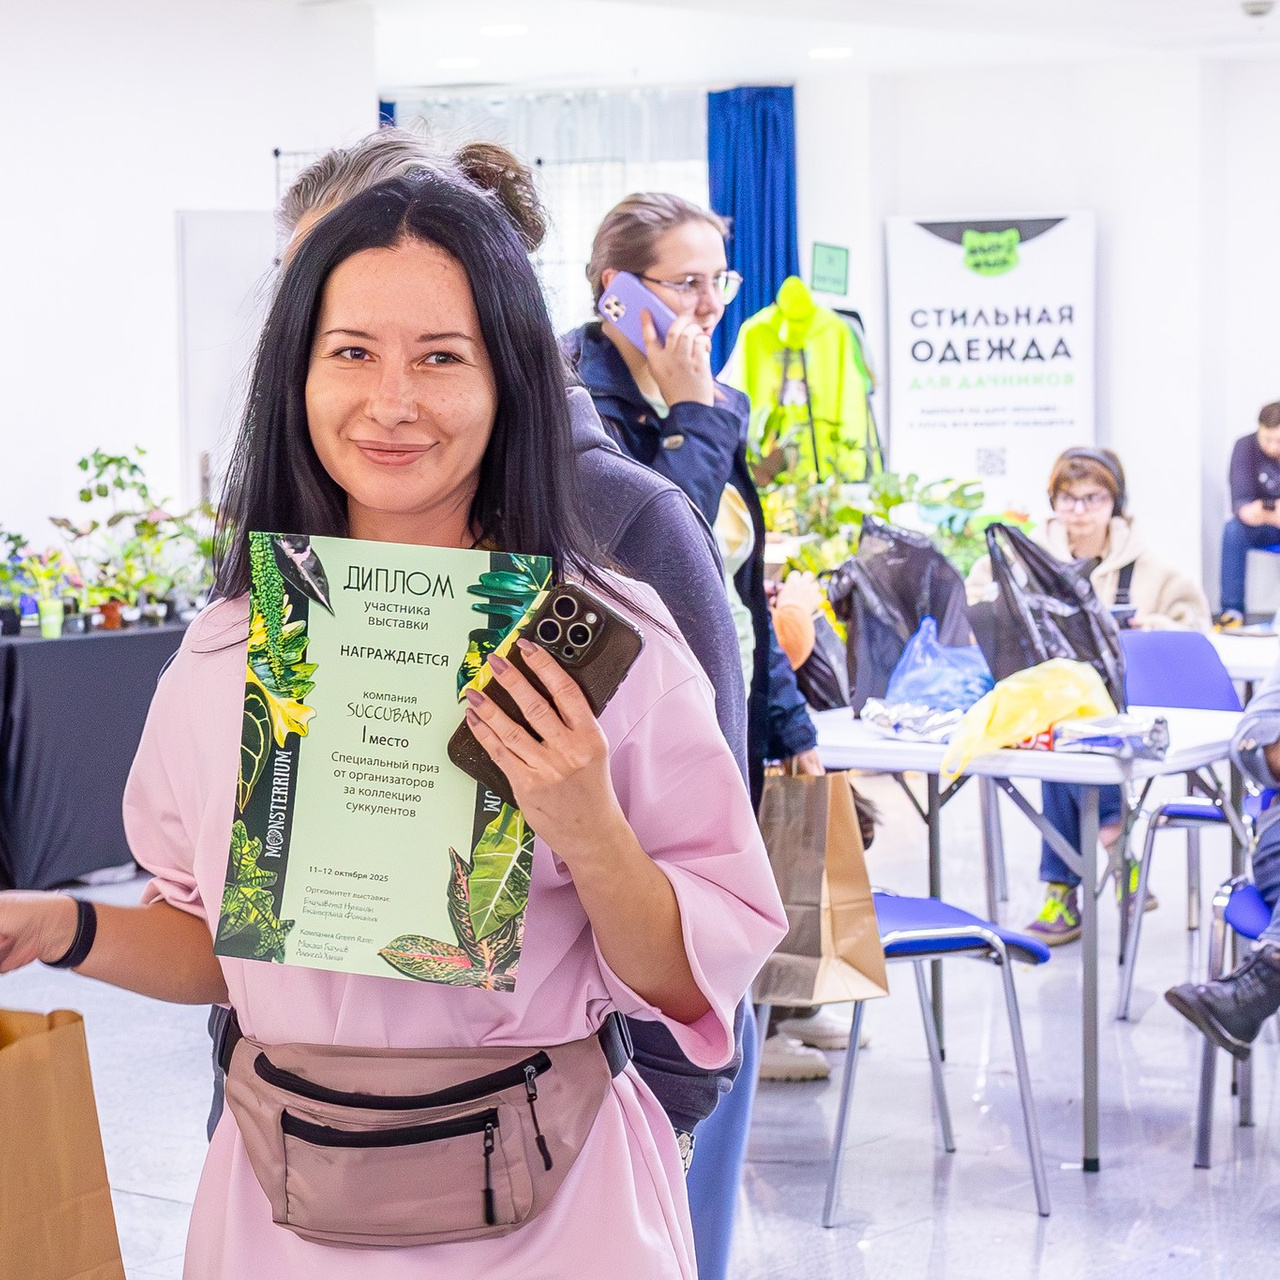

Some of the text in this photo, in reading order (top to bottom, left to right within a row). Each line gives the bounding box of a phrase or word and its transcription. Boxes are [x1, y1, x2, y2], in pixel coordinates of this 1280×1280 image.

[910, 305, 1074, 328] СТИЛЬНАЯ
[911, 337, 1072, 364] ОДЕЖДА
[343, 565, 455, 599] ДИПЛОМ
[364, 600, 431, 616] участника
[368, 616, 429, 631] выставки
[340, 644, 450, 667] НАГРАЖДАЕТСЯ
[362, 690, 418, 705] компания
[346, 701, 433, 726] SUCCUBAND
[368, 734, 410, 749] место
[331, 750, 440, 774] Специальный приз
[333, 768, 435, 789] от организаторов
[343, 785, 422, 803] за коллекцию
[345, 801, 417, 818] суккулентов
[334, 870, 368, 880] октября
[369, 873, 389, 883] 2025
[305, 886, 352, 898] Оргкомитет
